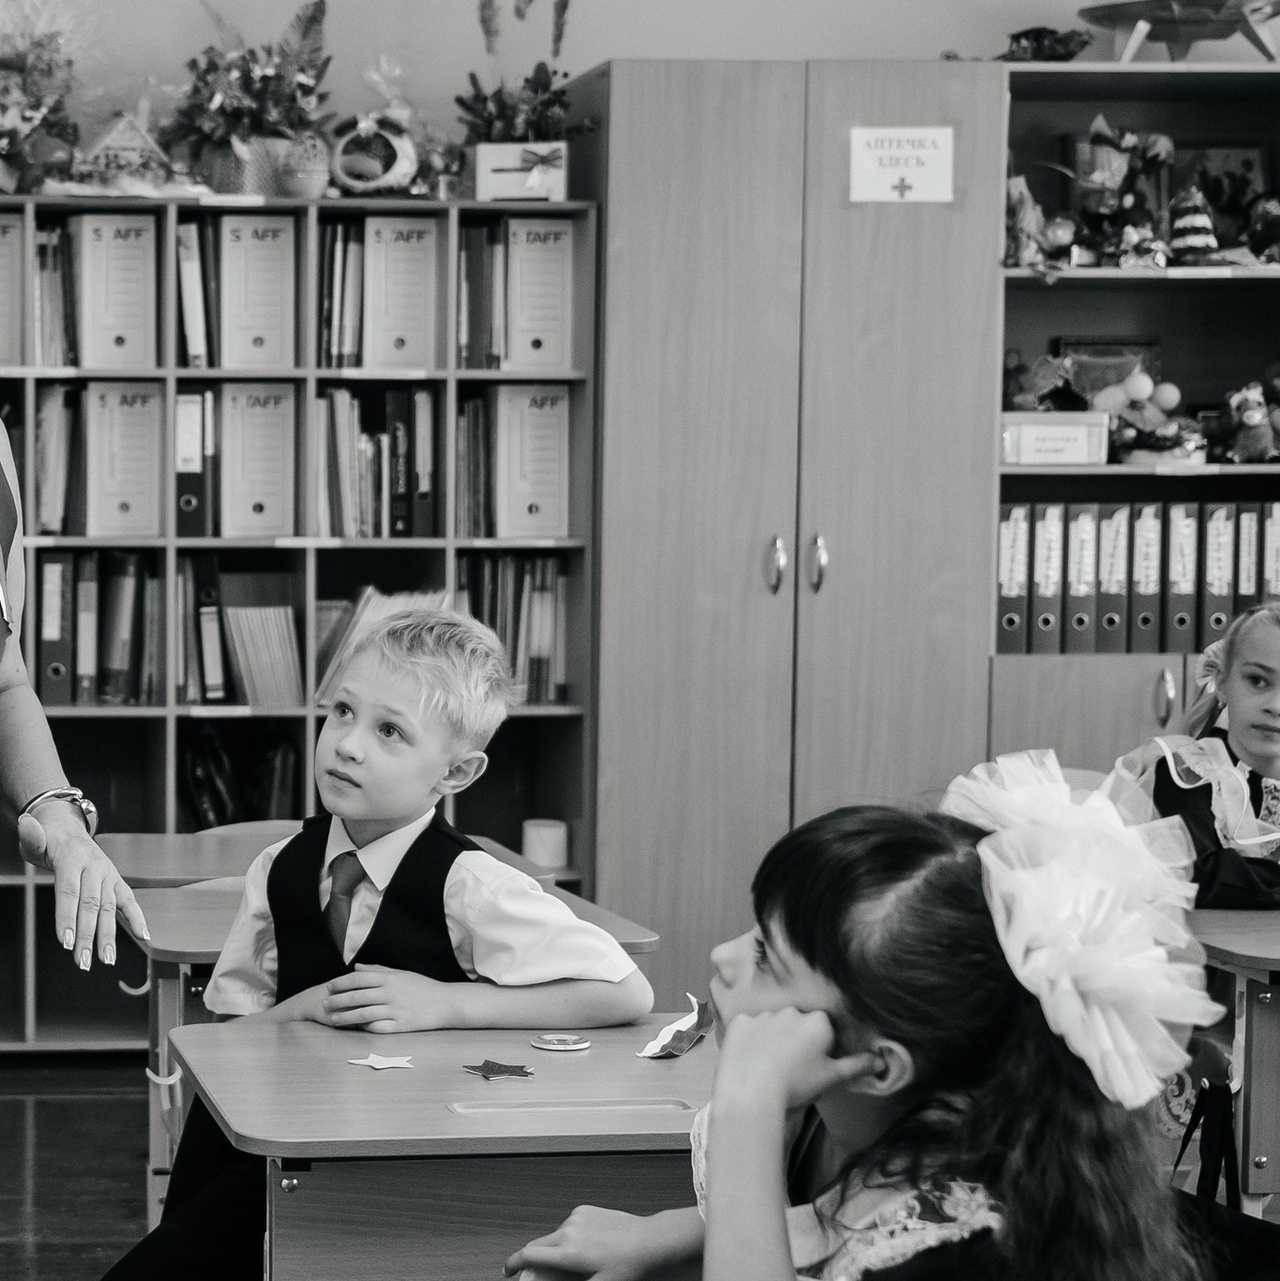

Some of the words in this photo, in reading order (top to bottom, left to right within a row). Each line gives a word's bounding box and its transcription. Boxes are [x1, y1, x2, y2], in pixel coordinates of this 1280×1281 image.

[91, 226, 147, 242] SAFF
[228, 226, 284, 242] SAFF
[373, 229, 428, 244] SAFF
